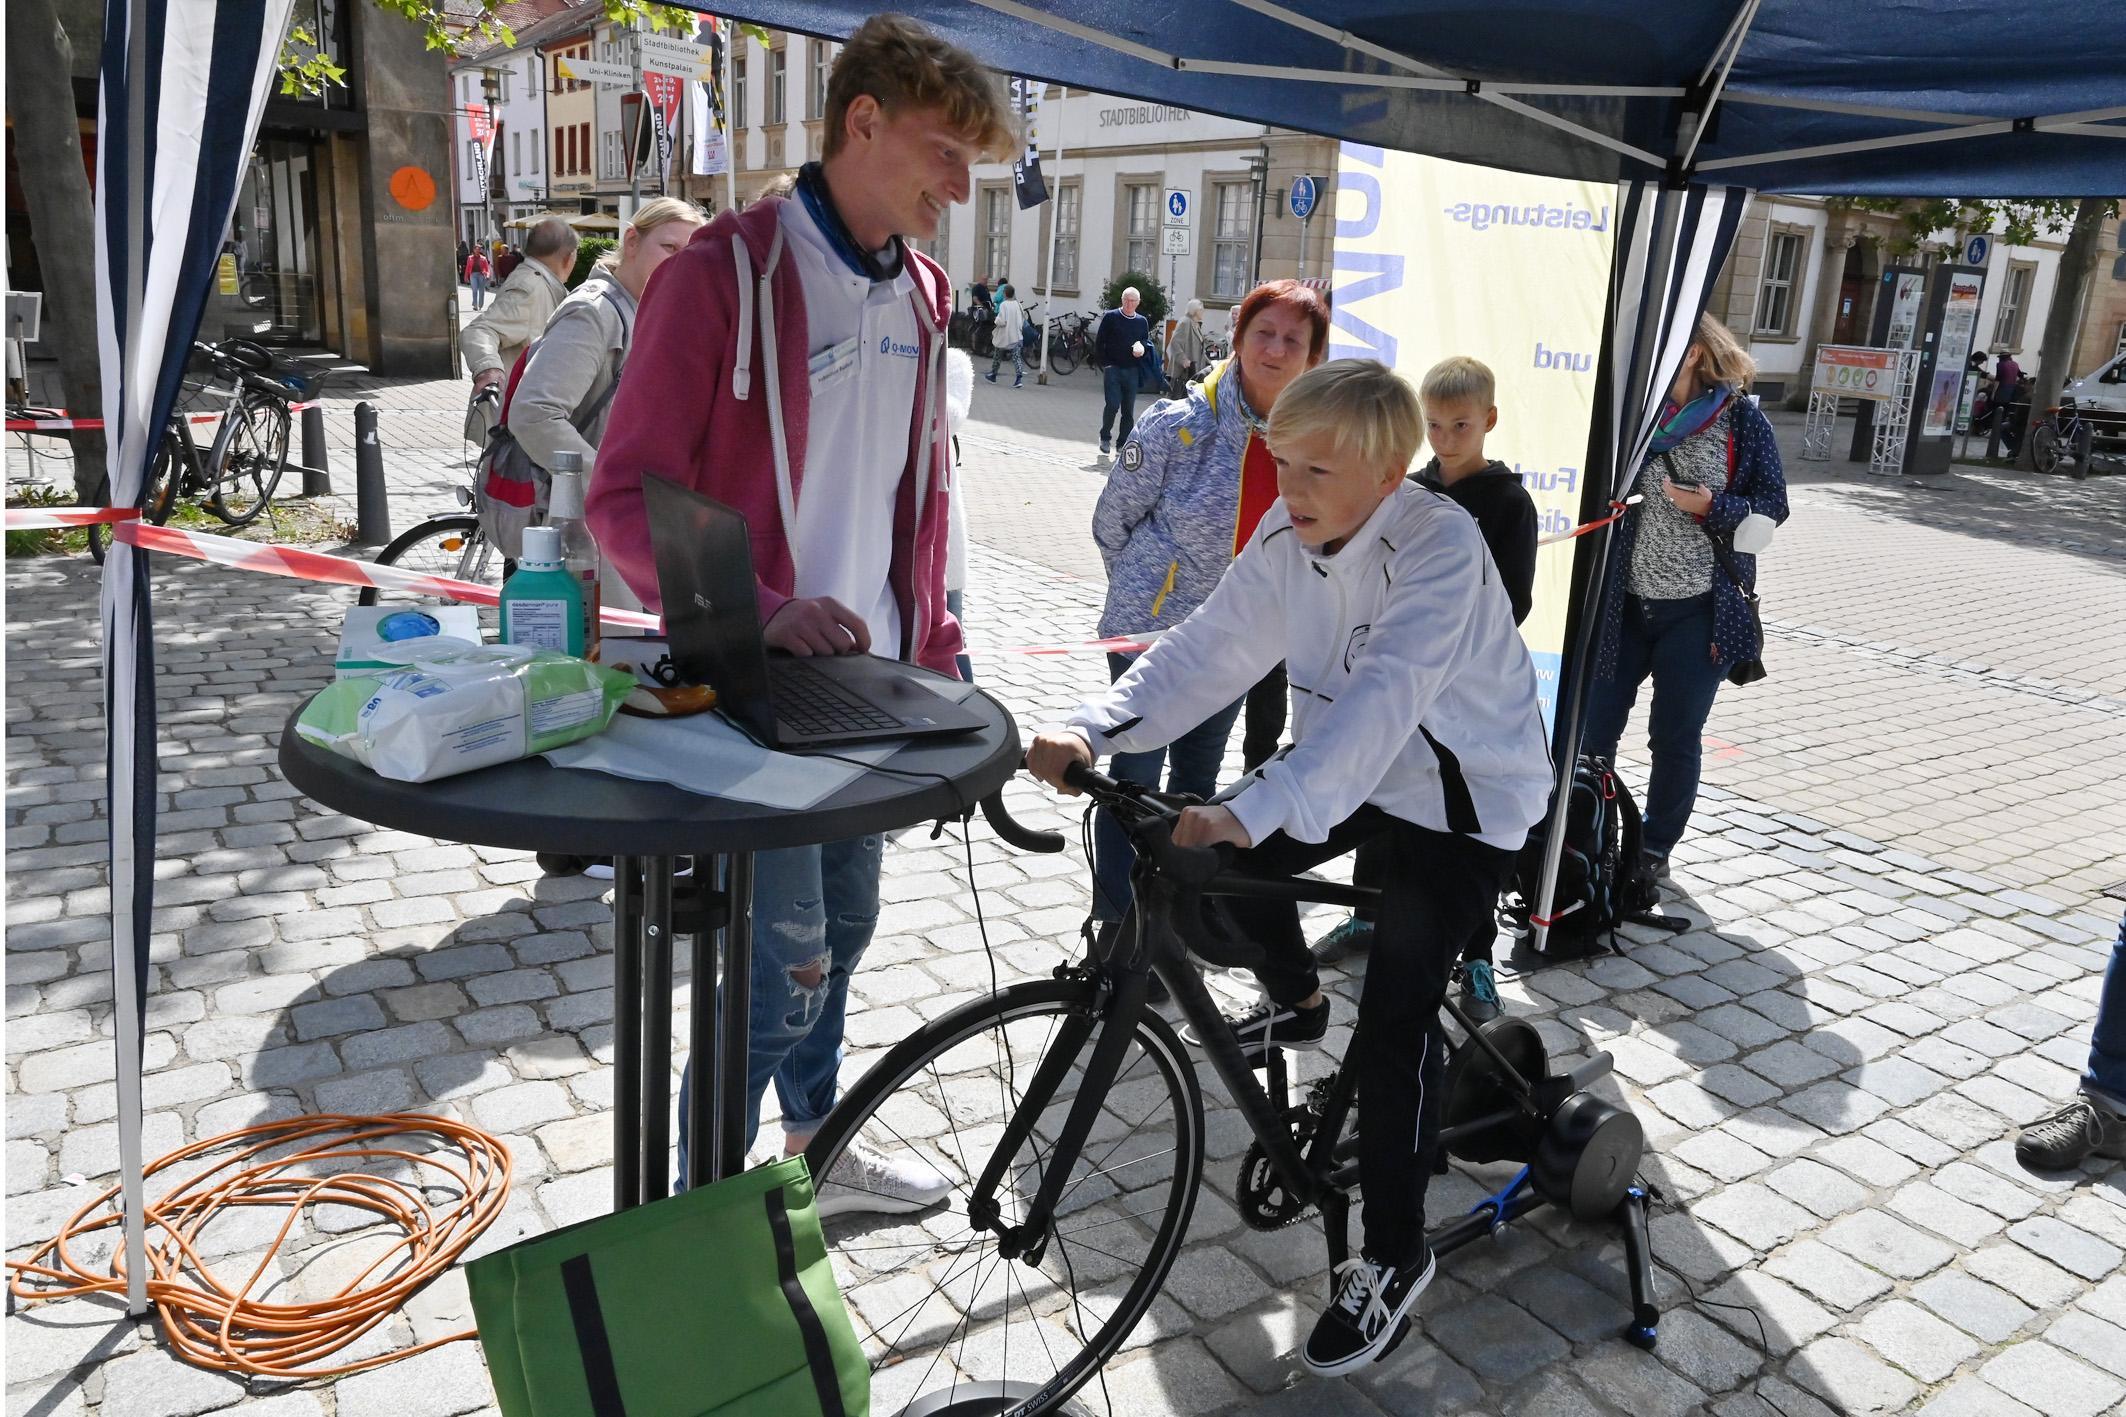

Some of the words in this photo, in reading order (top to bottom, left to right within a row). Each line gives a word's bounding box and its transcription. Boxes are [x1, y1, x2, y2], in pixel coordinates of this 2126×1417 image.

[643, 38, 700, 56] Stadtbibliothek
[588, 67, 632, 79] Uni-Kliniken
[649, 57, 693, 73] Kunstpalais
[1170, 217, 1185, 225] ZONE
[1026, 1391, 1049, 1412] SWISS
